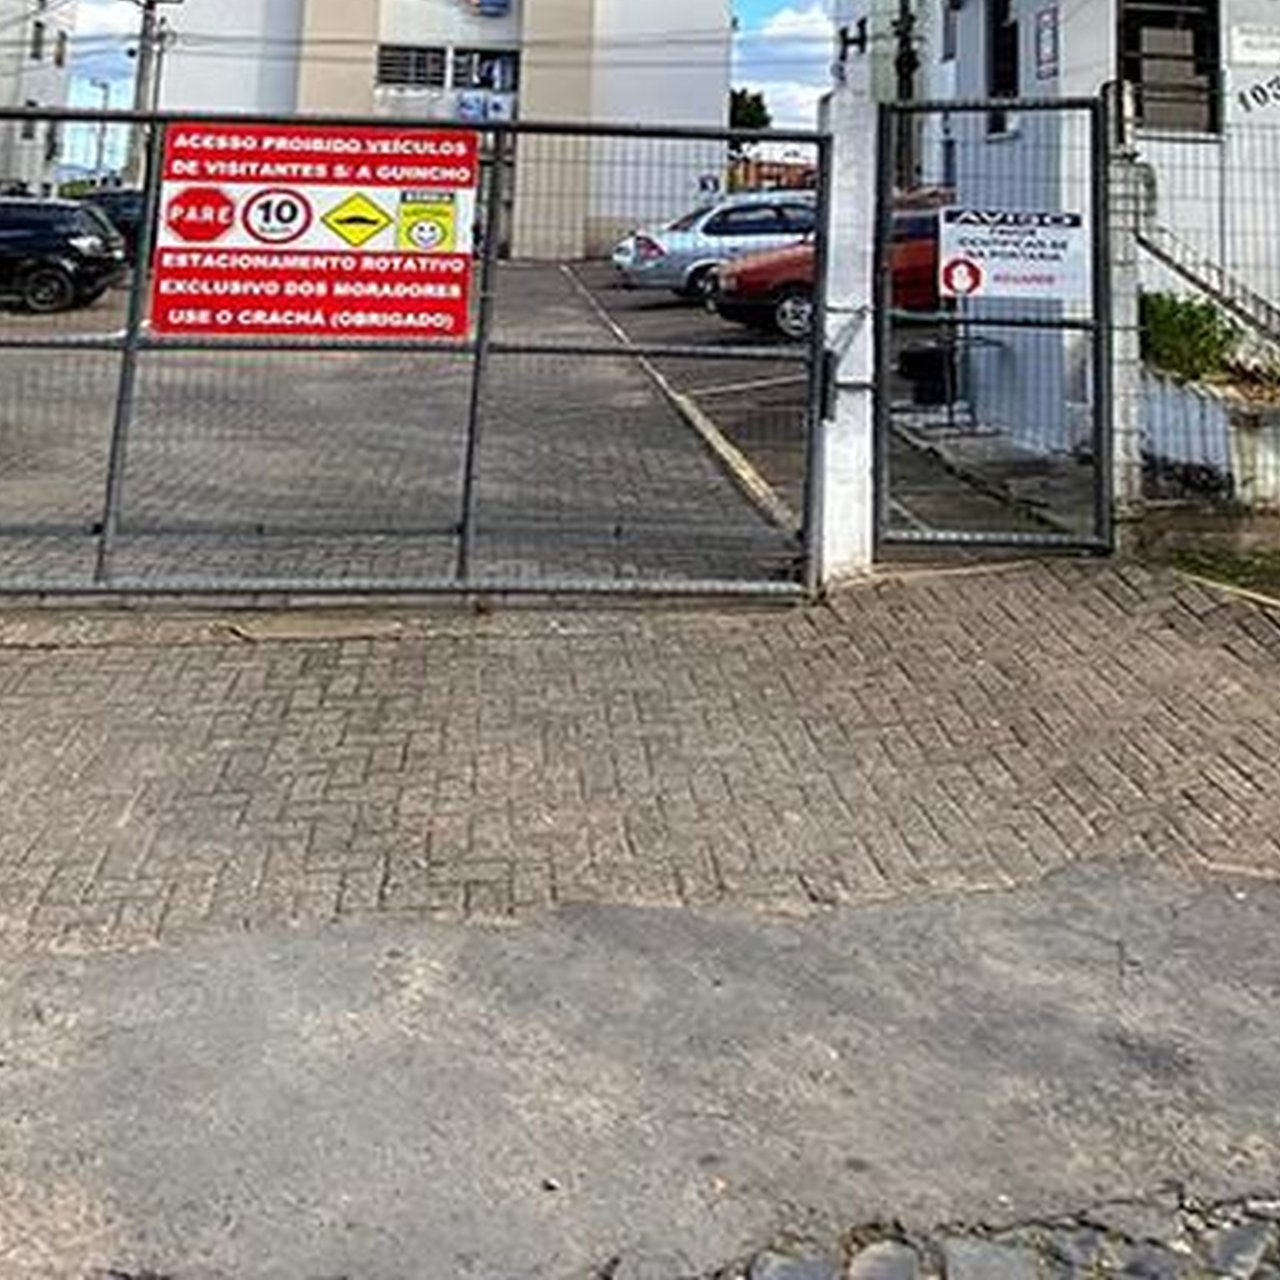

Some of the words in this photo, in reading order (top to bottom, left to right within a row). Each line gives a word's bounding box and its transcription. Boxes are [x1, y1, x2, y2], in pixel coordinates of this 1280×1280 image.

[173, 133, 256, 151] ACESSO
[261, 135, 361, 153] PROIBIDO
[365, 137, 468, 156] VEÍCULOS
[171, 159, 198, 176] DE
[203, 161, 327, 178] VISITANTES
[356, 165, 371, 179] A
[376, 165, 471, 182] GUINCHO
[170, 204, 232, 224] PARE
[257, 200, 298, 224] 10
[957, 211, 1074, 227] AVISO
[162, 252, 357, 271] ESTACIONAMENTO
[361, 256, 465, 273] ROTATIVO
[159, 278, 280, 296] EXCLUSIVO
[283, 279, 328, 297] DOS
[332, 280, 462, 299] MORADORES
[169, 308, 211, 324] USE
[215, 308, 233, 325] O
[329, 310, 455, 330] (OBRIGADO)
